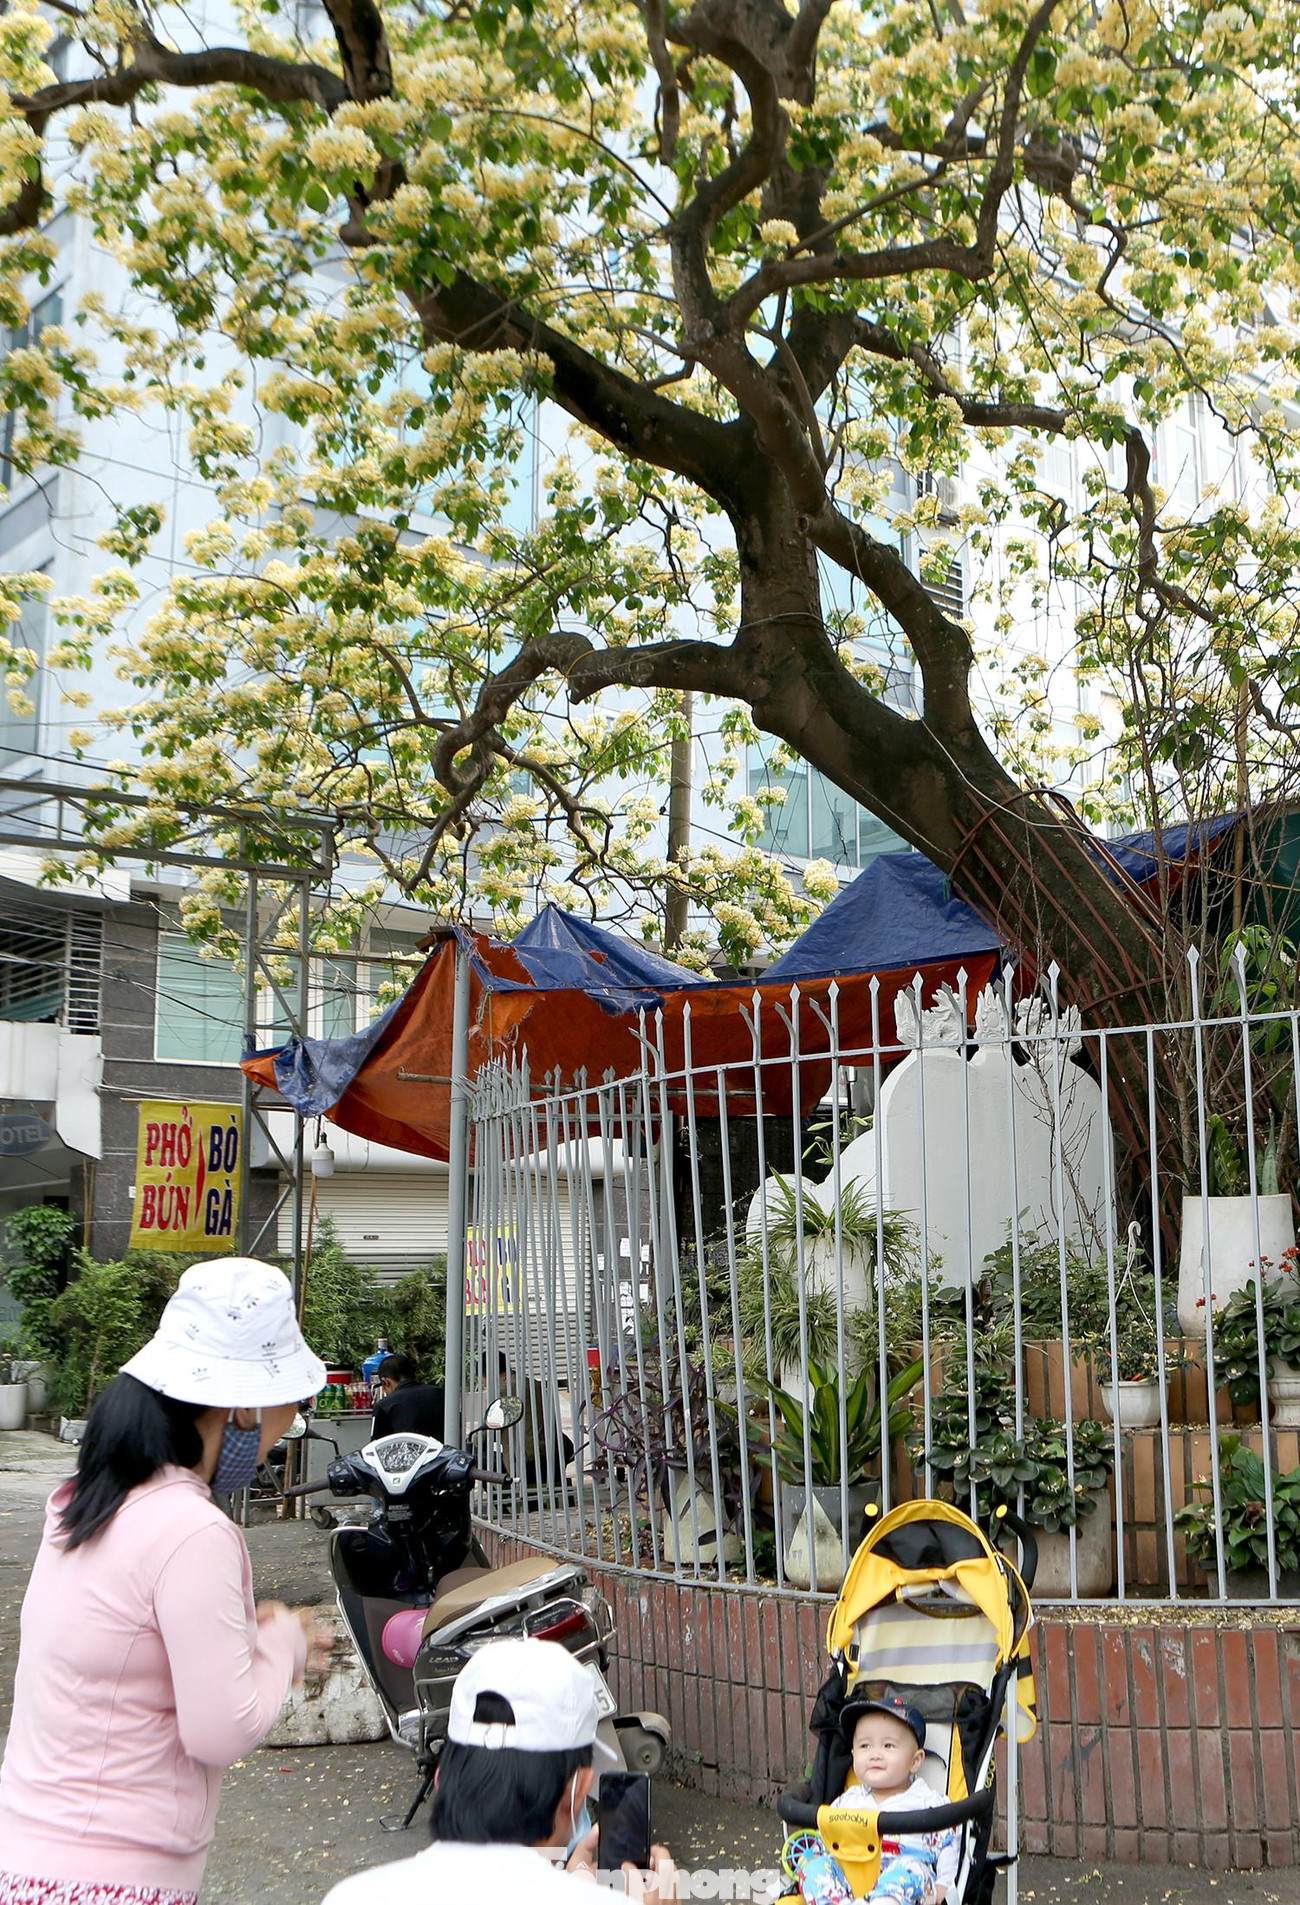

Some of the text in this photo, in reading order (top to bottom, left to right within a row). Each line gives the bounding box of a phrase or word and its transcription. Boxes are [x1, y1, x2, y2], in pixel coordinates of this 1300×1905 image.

[0, 1124, 49, 1145] OTEL
[145, 1105, 239, 1174] PHỞ BÒ
[139, 1172, 233, 1236] BÚN GÀ
